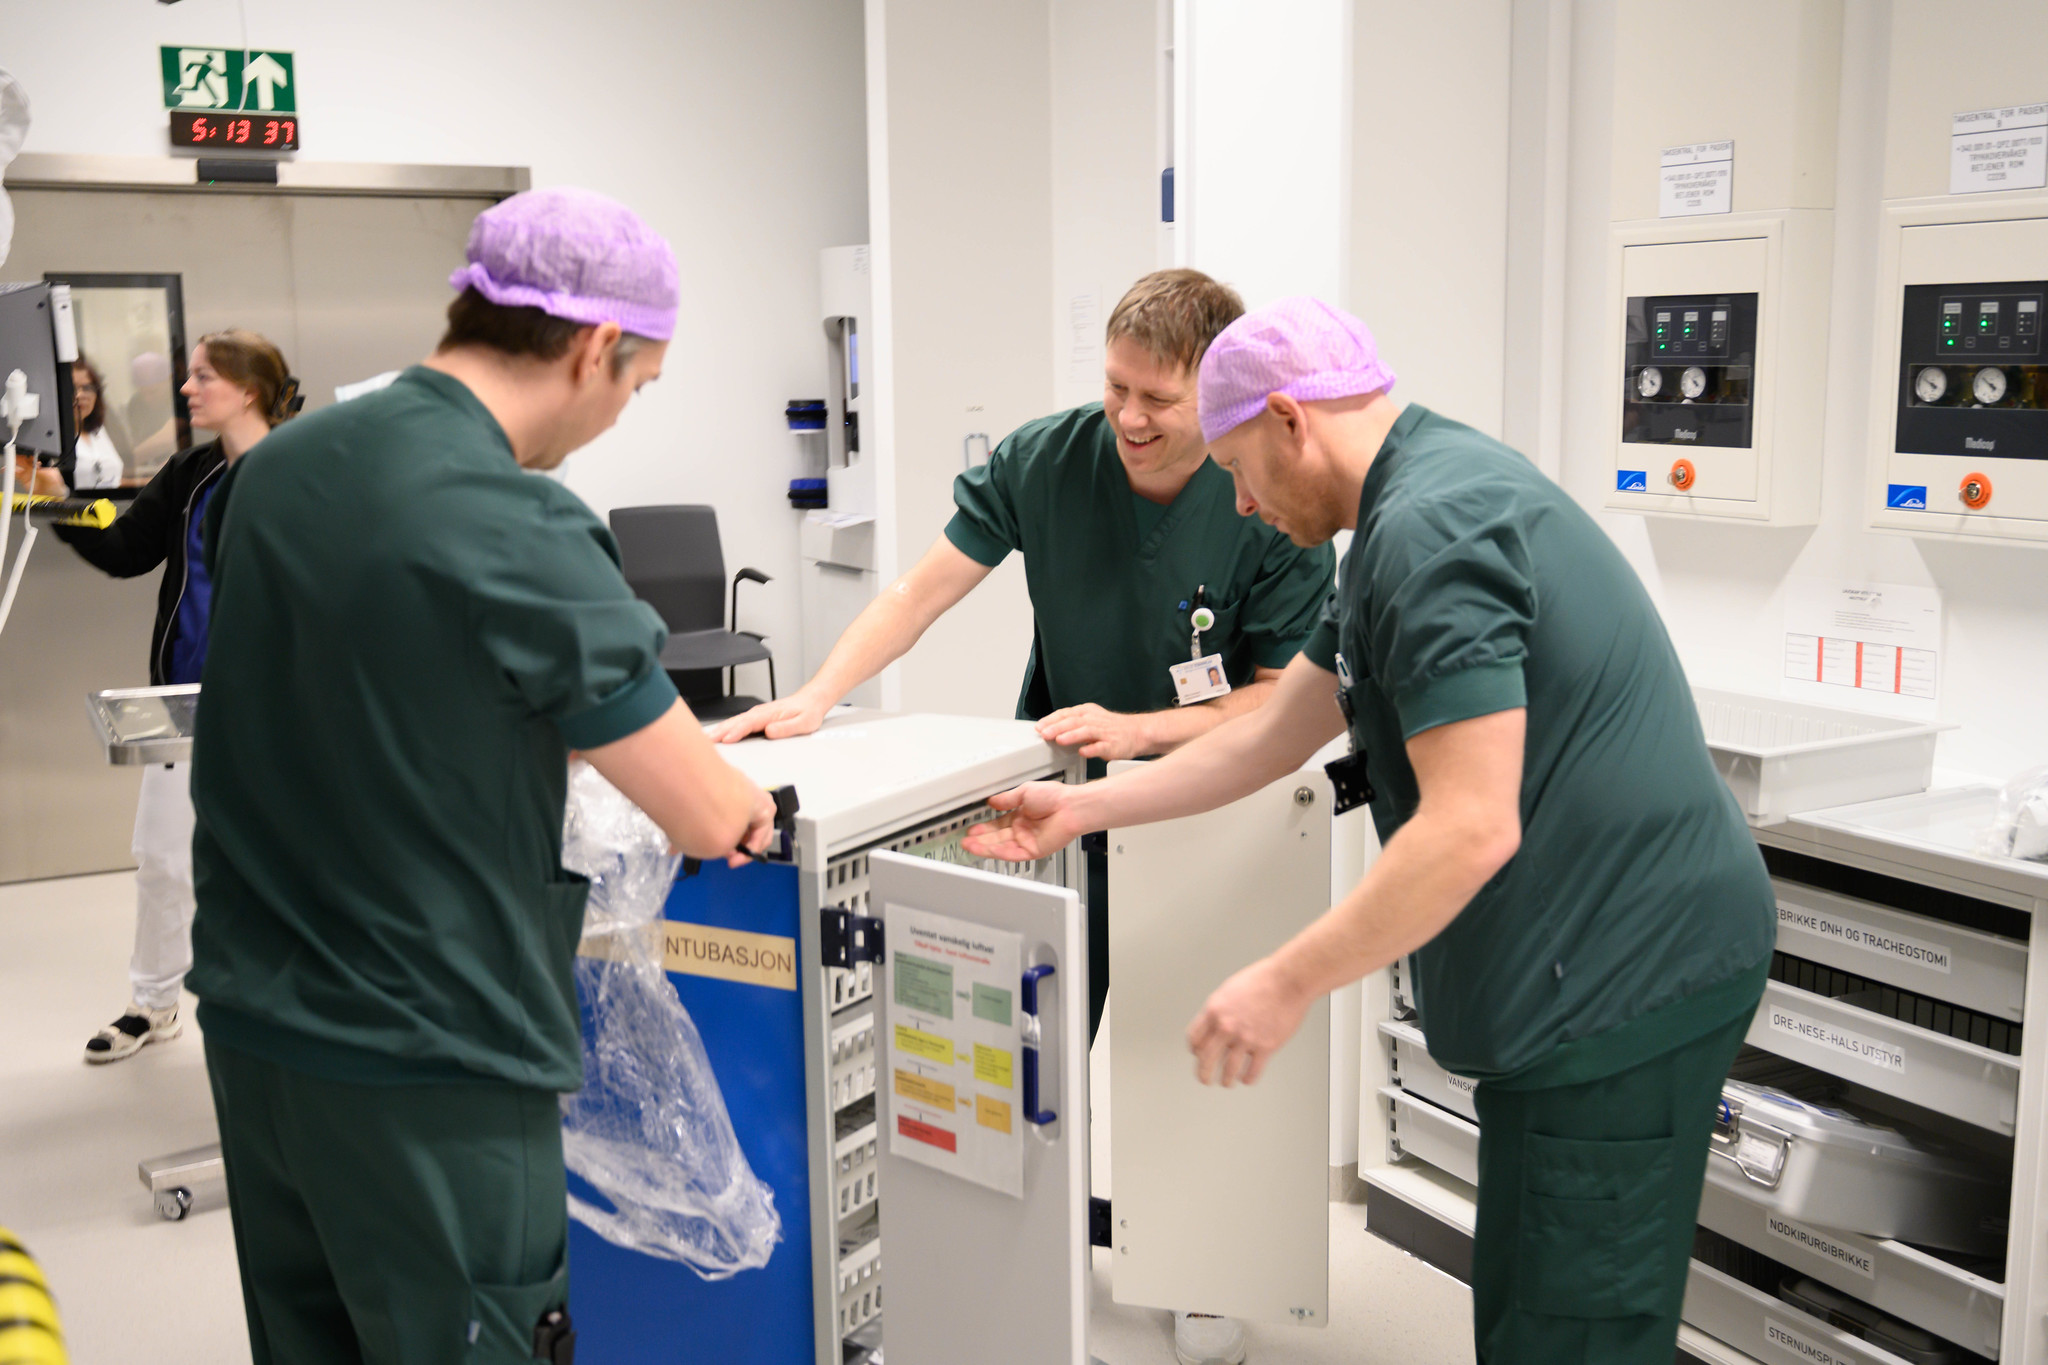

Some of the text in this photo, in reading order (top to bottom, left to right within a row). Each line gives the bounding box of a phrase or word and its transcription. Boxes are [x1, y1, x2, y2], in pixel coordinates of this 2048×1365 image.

[264, 121, 295, 144] 37
[1846, 928, 1860, 942] OG
[1863, 932, 1947, 967] TRACHEOSTOMI
[1773, 1014, 1902, 1068] ØRE-NESE-HALS UTSTYR
[1770, 1218, 1869, 1272] NØDKIRURGIBRIKKE
